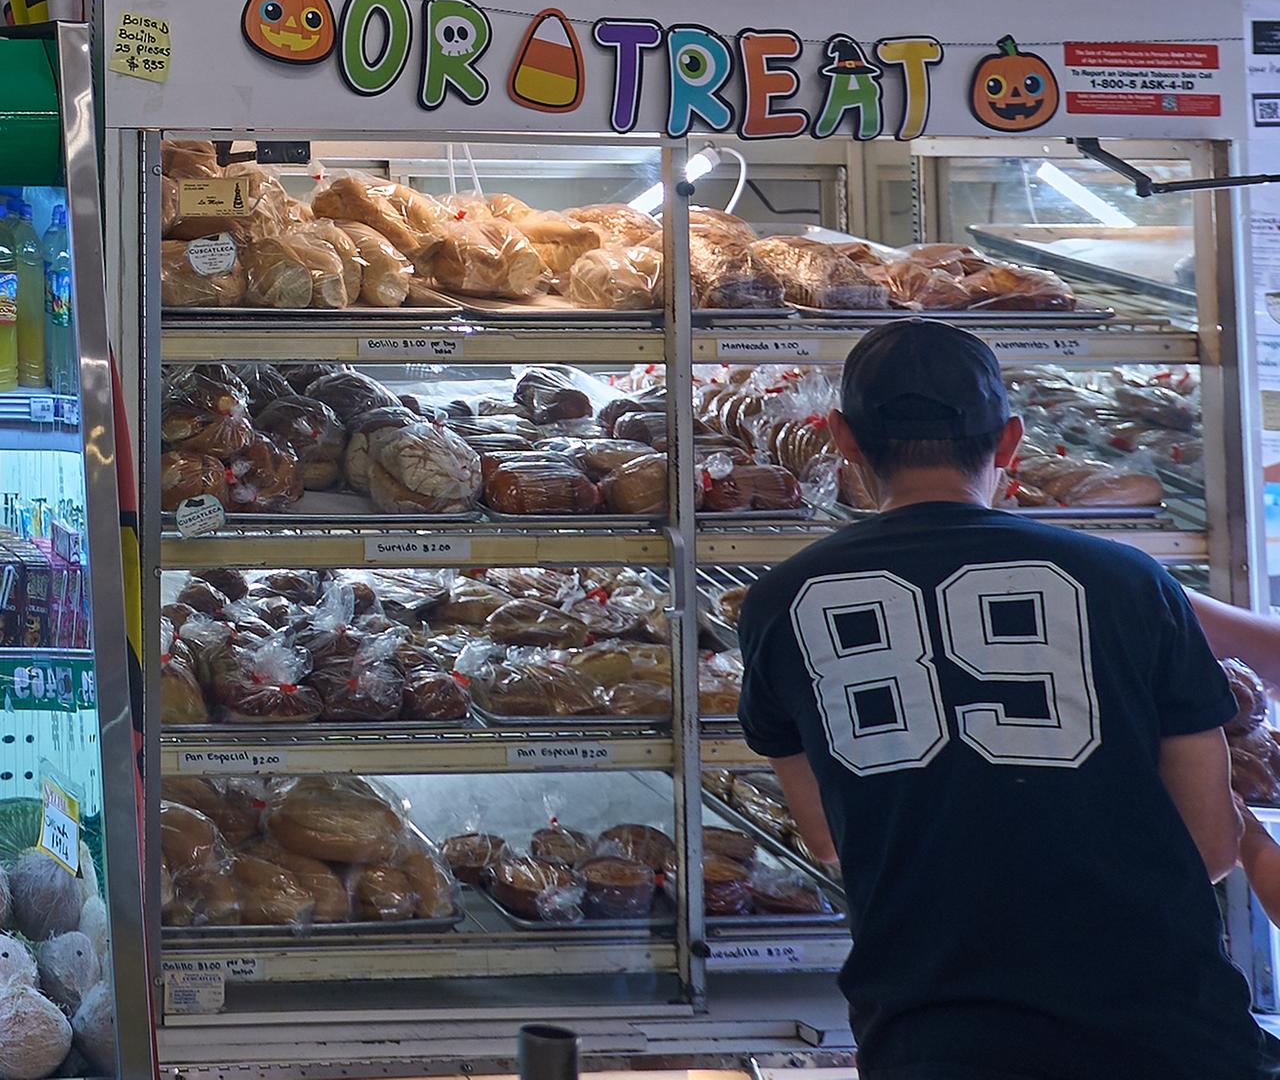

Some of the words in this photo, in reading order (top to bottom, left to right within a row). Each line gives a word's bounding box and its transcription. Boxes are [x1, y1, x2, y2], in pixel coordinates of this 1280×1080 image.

[123, 14, 158, 29] Bolsa
[119, 28, 157, 43] Bolillo
[115, 43, 131, 53] 25
[592, 17, 944, 141] TREAT
[1082, 70, 1106, 78] Report
[1118, 70, 1149, 78] Unlawful
[1151, 71, 1179, 79] Tobacco
[1090, 79, 1137, 89] 1-800-5
[1141, 80, 1194, 91] ASK-4-ID
[368, 340, 398, 348] Bolillo
[378, 543, 418, 553] Surtido
[789, 560, 1102, 777] 89
[185, 752, 203, 762] Pan
[207, 751, 250, 765] Especial
[518, 749, 536, 758] Pan
[541, 747, 579, 760] Especial
